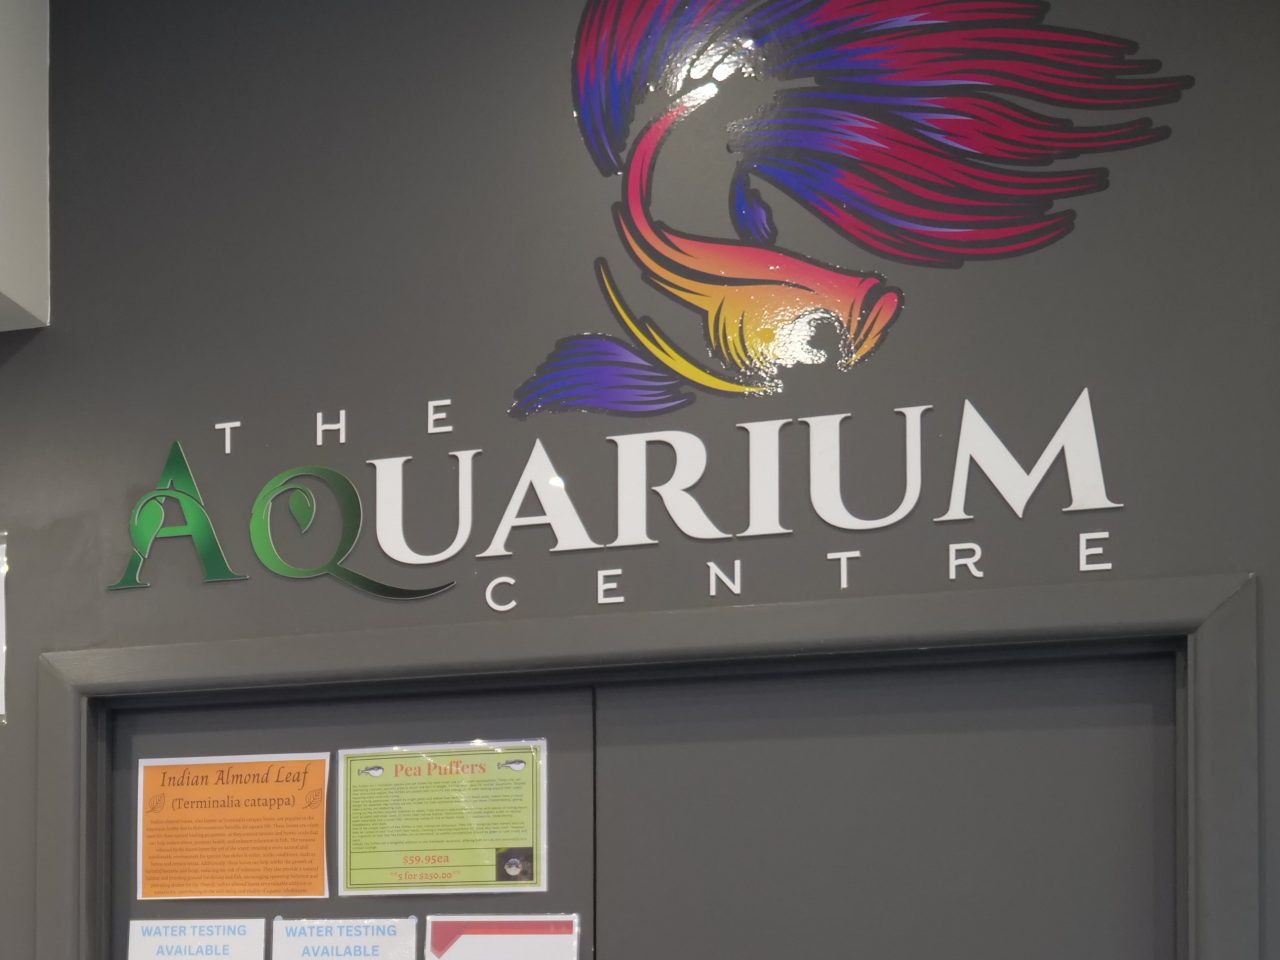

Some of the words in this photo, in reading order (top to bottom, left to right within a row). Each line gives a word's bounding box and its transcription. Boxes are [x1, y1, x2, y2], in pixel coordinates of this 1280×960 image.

[215, 399, 453, 456] THE
[107, 387, 1125, 600] AQUARIUM
[484, 531, 1113, 612] CENTRE
[160, 767, 208, 788] Indian
[214, 763, 269, 787] Almond
[275, 762, 312, 790] Leaf
[394, 763, 422, 778] Pea
[427, 758, 487, 777] Puffers
[171, 796, 241, 812] (Terminalia
[244, 794, 296, 811] catappa)
[402, 854, 450, 865] $59.95ea
[141, 925, 187, 937] WATER
[191, 924, 248, 937] TESTING
[285, 925, 333, 937] WATER
[337, 924, 397, 937] TESTING
[155, 944, 231, 956] AVAILABLE
[301, 945, 380, 957] AVAILABLE
